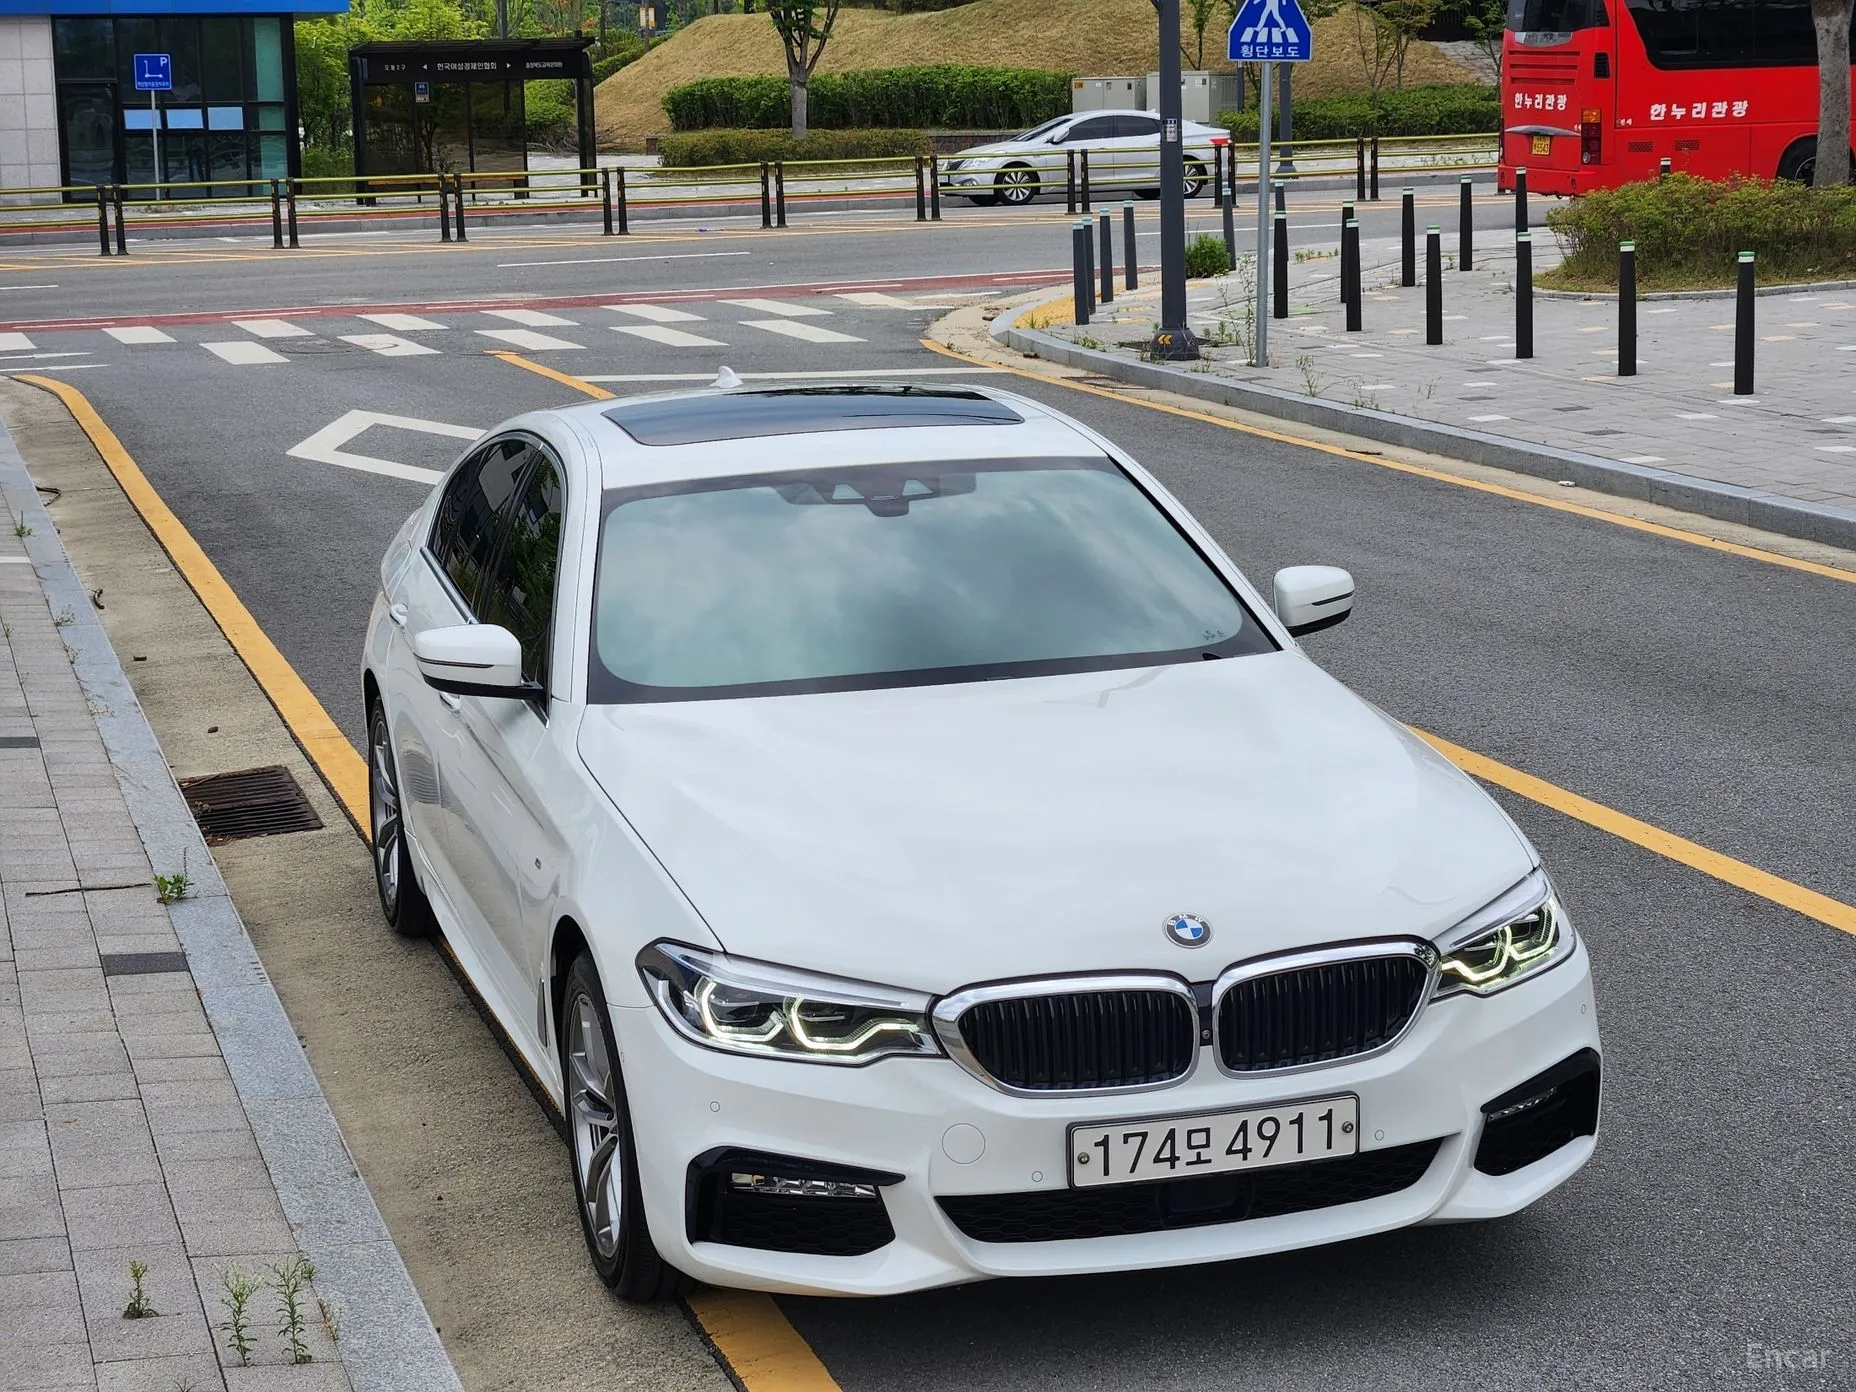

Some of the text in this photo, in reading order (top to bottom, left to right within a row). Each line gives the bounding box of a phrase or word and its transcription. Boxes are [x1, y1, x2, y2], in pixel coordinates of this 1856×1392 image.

[1240, 44, 1300, 58] 횡단보도
[159, 56, 168, 67] P
[436, 61, 498, 71] 한국여성경제인협회
[1513, 92, 1568, 111] 한누리관광
[1649, 100, 1749, 121] 한누리관광
[1167, 913, 1204, 926] BMW
[1093, 1108, 1334, 1177] 174모 4911
